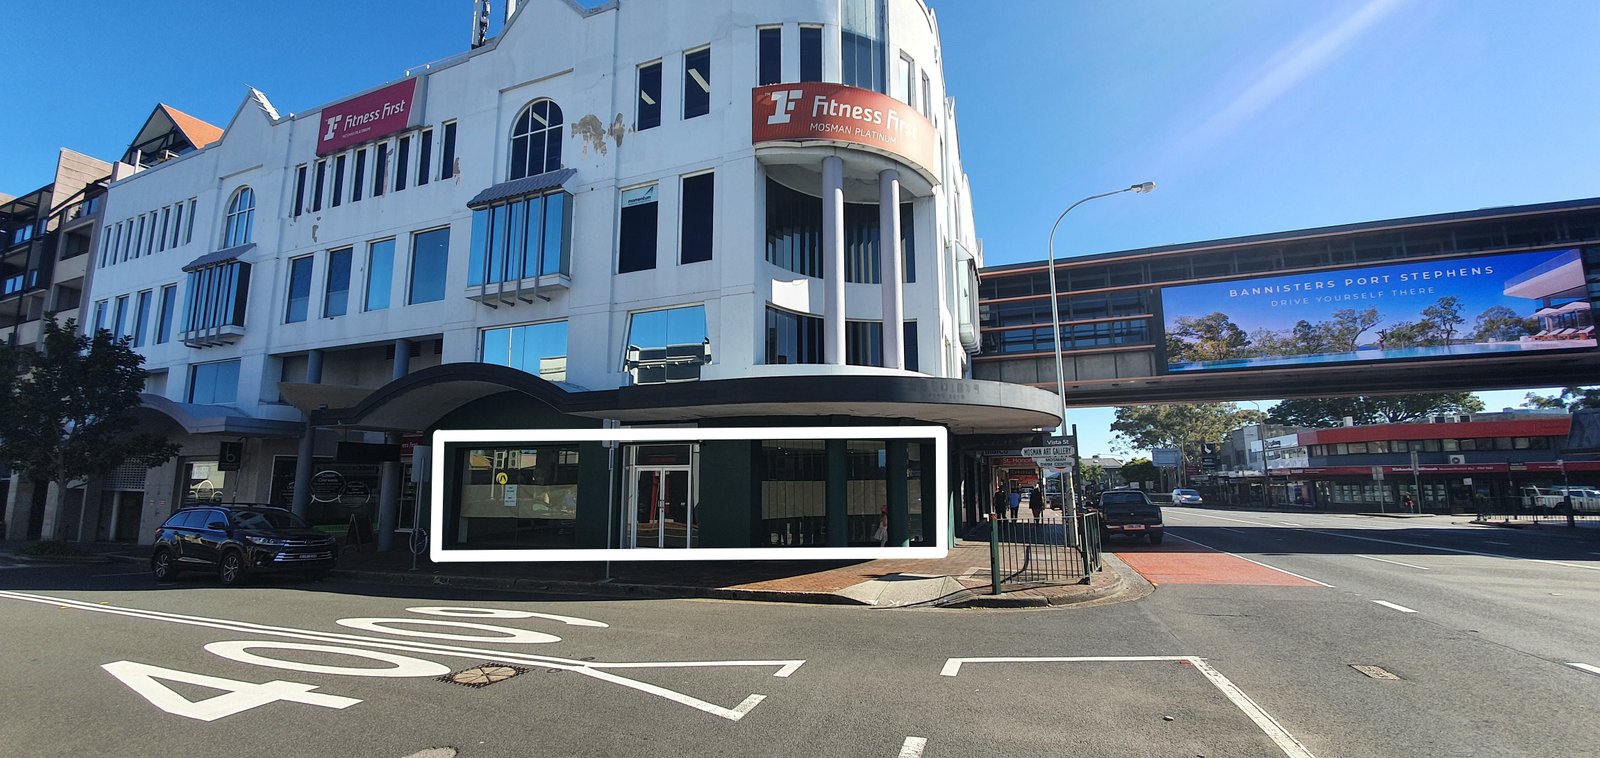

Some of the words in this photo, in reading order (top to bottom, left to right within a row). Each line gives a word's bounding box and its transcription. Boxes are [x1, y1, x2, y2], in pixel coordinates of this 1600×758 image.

[343, 109, 381, 131] Fitness
[381, 99, 406, 120] First
[812, 95, 882, 125] Fitness
[886, 109, 918, 139] First
[810, 123, 852, 135] MOSMAN
[855, 128, 897, 145] PLATINUM
[1229, 279, 1336, 297] BANNISTERS
[1345, 274, 1391, 287] PORT
[1399, 265, 1495, 282] STEPHENS
[1271, 296, 1310, 307] DRIVE
[1315, 291, 1385, 303] YOURSELF
[1392, 286, 1436, 296] THERE
[1023, 448, 1042, 456] MOSMAN
[1043, 447, 1051, 455] ART
[1052, 447, 1072, 455] GALLERY
